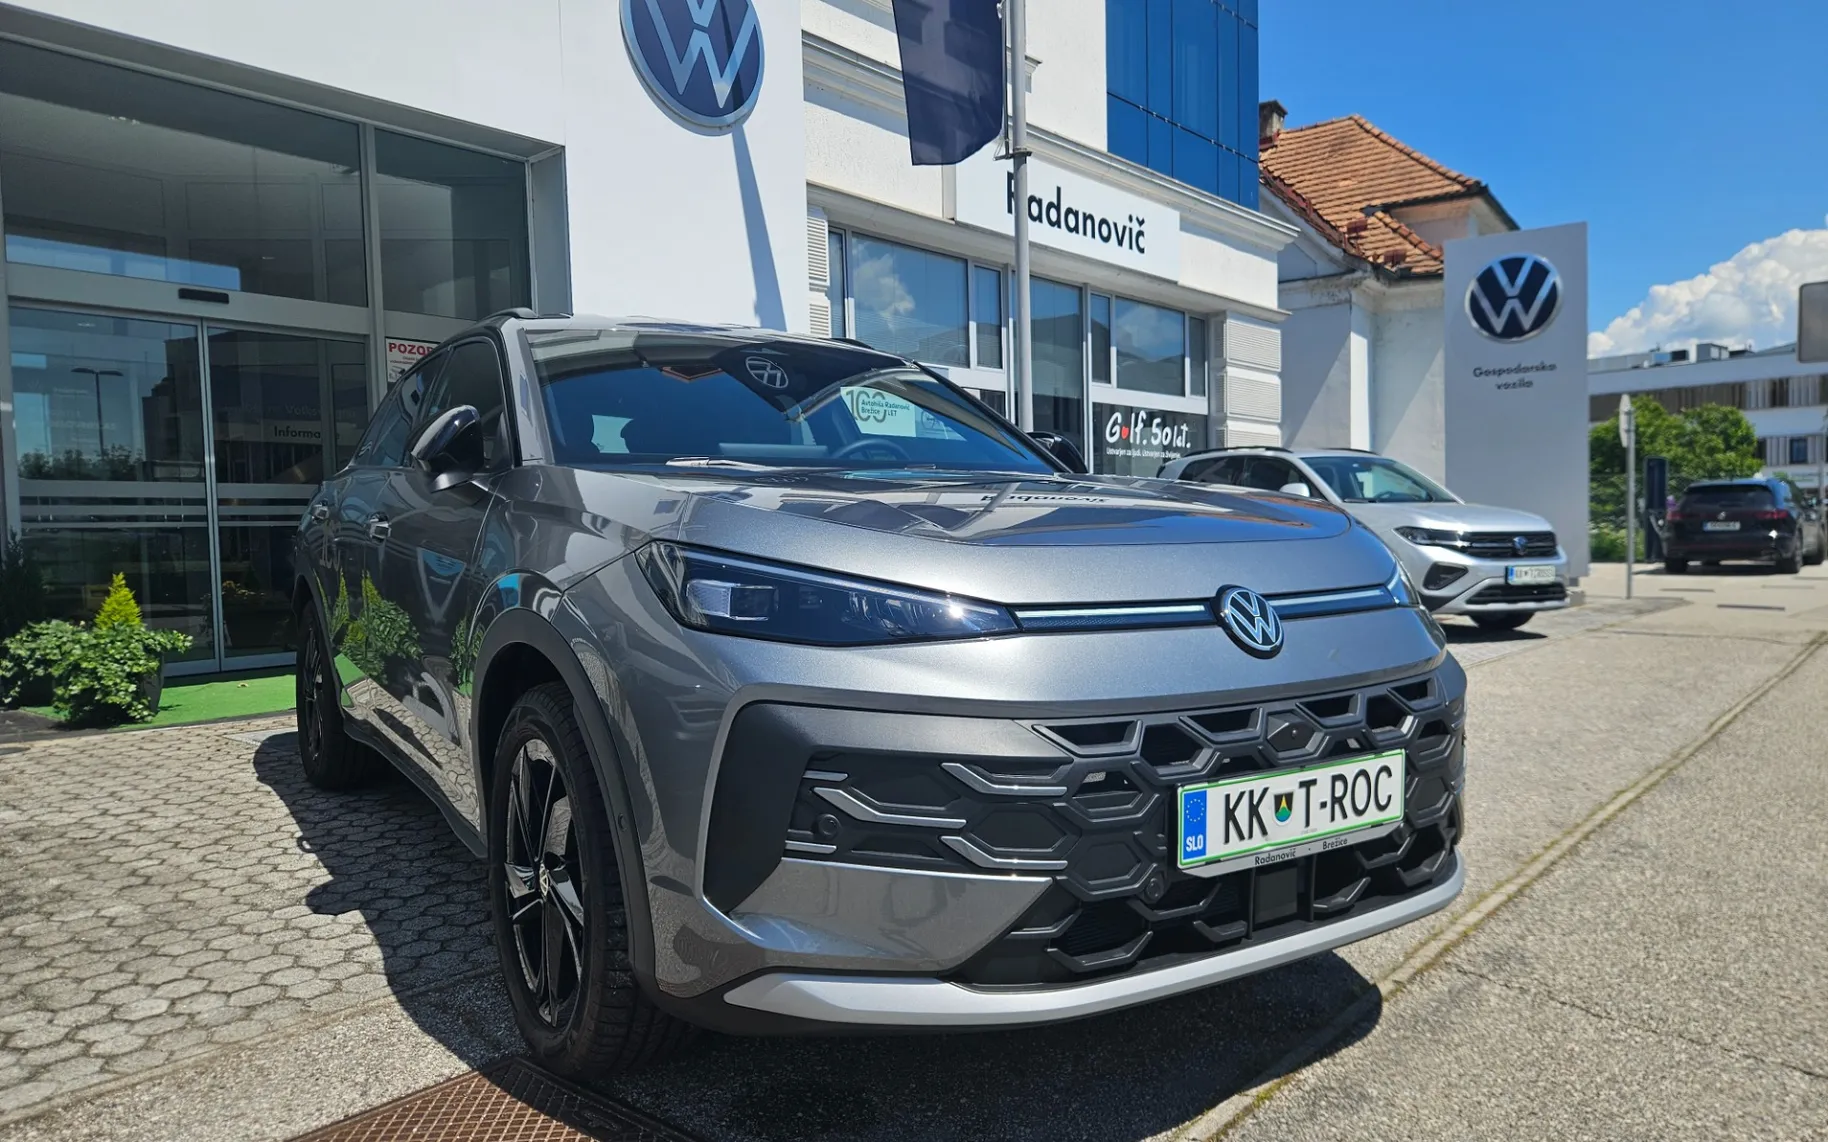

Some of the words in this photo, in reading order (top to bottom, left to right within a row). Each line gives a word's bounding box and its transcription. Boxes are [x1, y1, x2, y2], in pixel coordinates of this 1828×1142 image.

[1223, 787, 1270, 845] KK
[1298, 764, 1393, 829] T-ROC
[1185, 834, 1204, 853] SLO
[1254, 848, 1297, 866] Radanovič
[1322, 837, 1348, 850] Brežice
